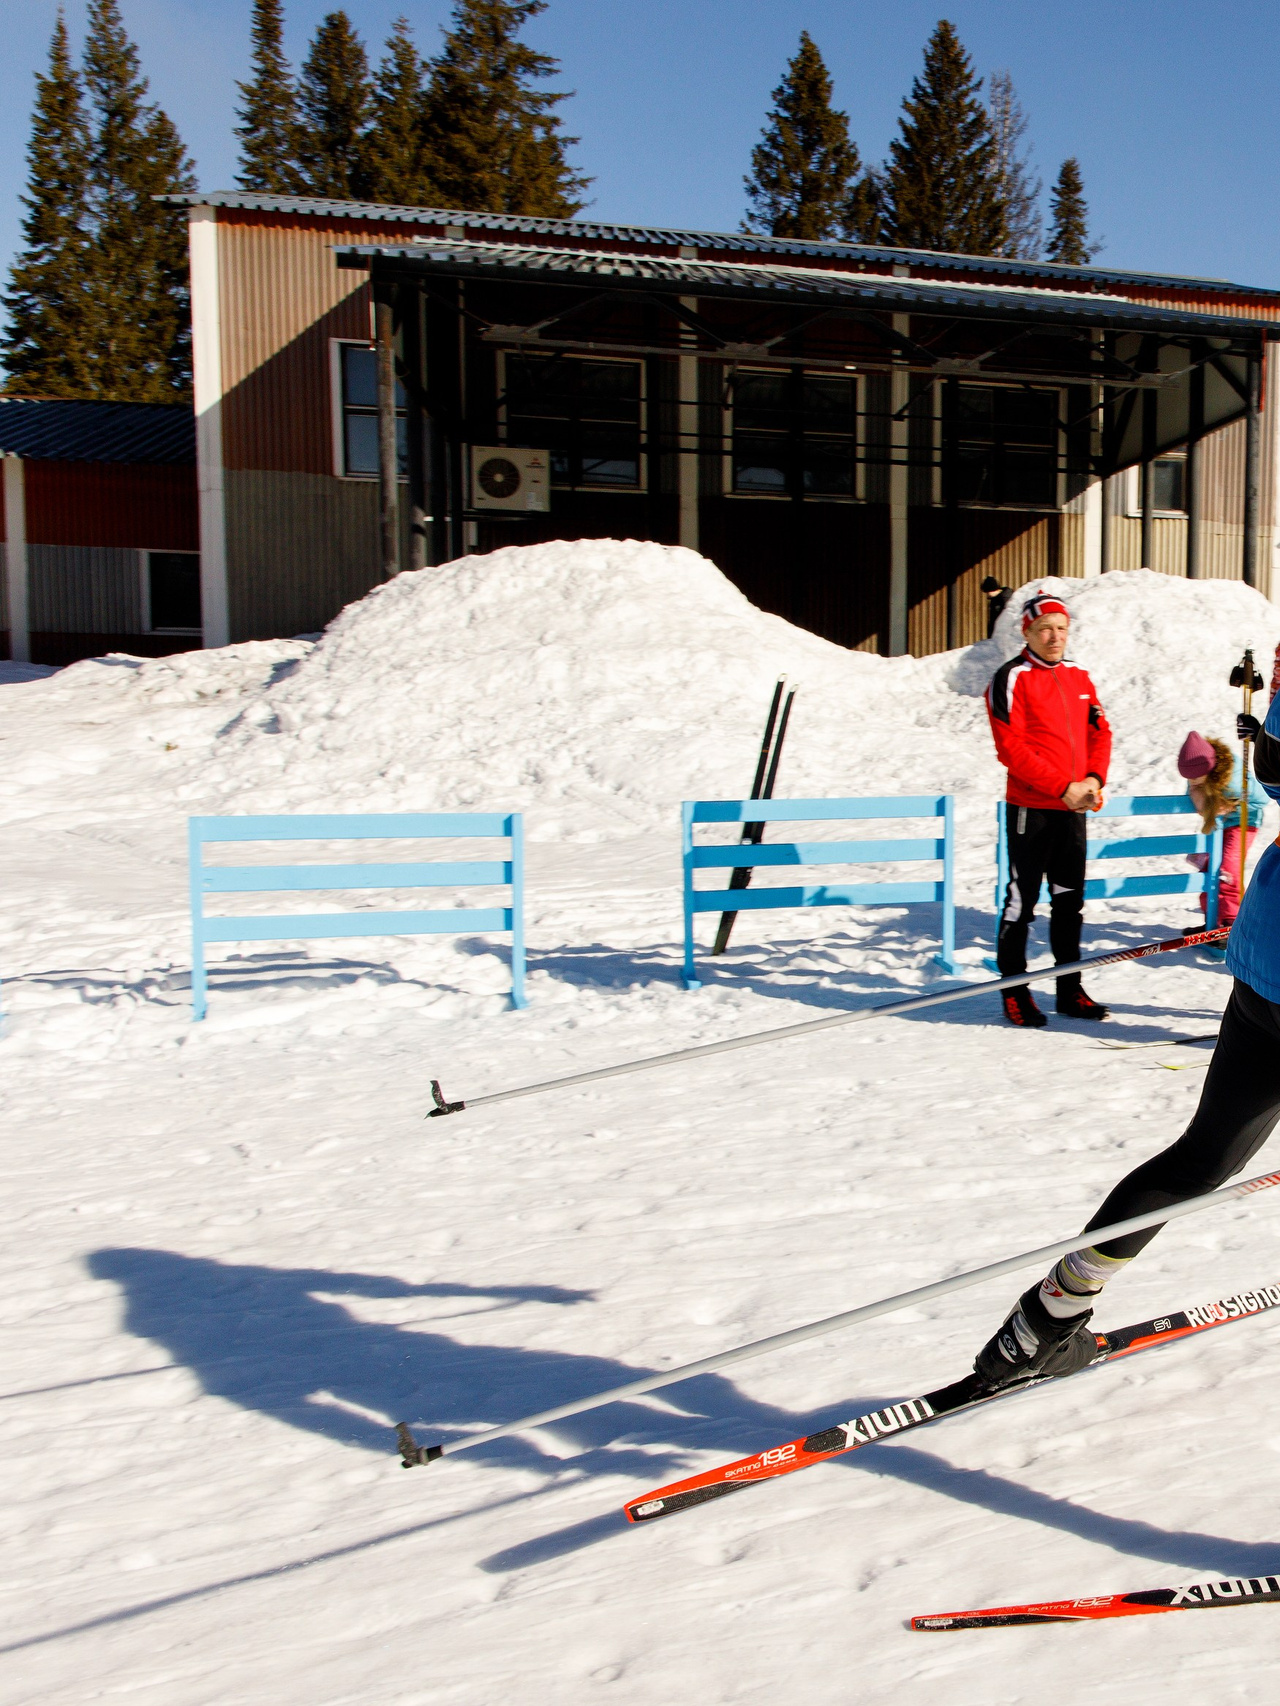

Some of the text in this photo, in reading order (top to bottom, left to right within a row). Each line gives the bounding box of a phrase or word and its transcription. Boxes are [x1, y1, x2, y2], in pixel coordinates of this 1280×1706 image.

[1154, 1319, 1172, 1332] S1
[724, 1461, 762, 1480] SKATING
[758, 1444, 797, 1468] 192
[1028, 1603, 1070, 1613] SKATING
[1069, 1596, 1114, 1608] 192
